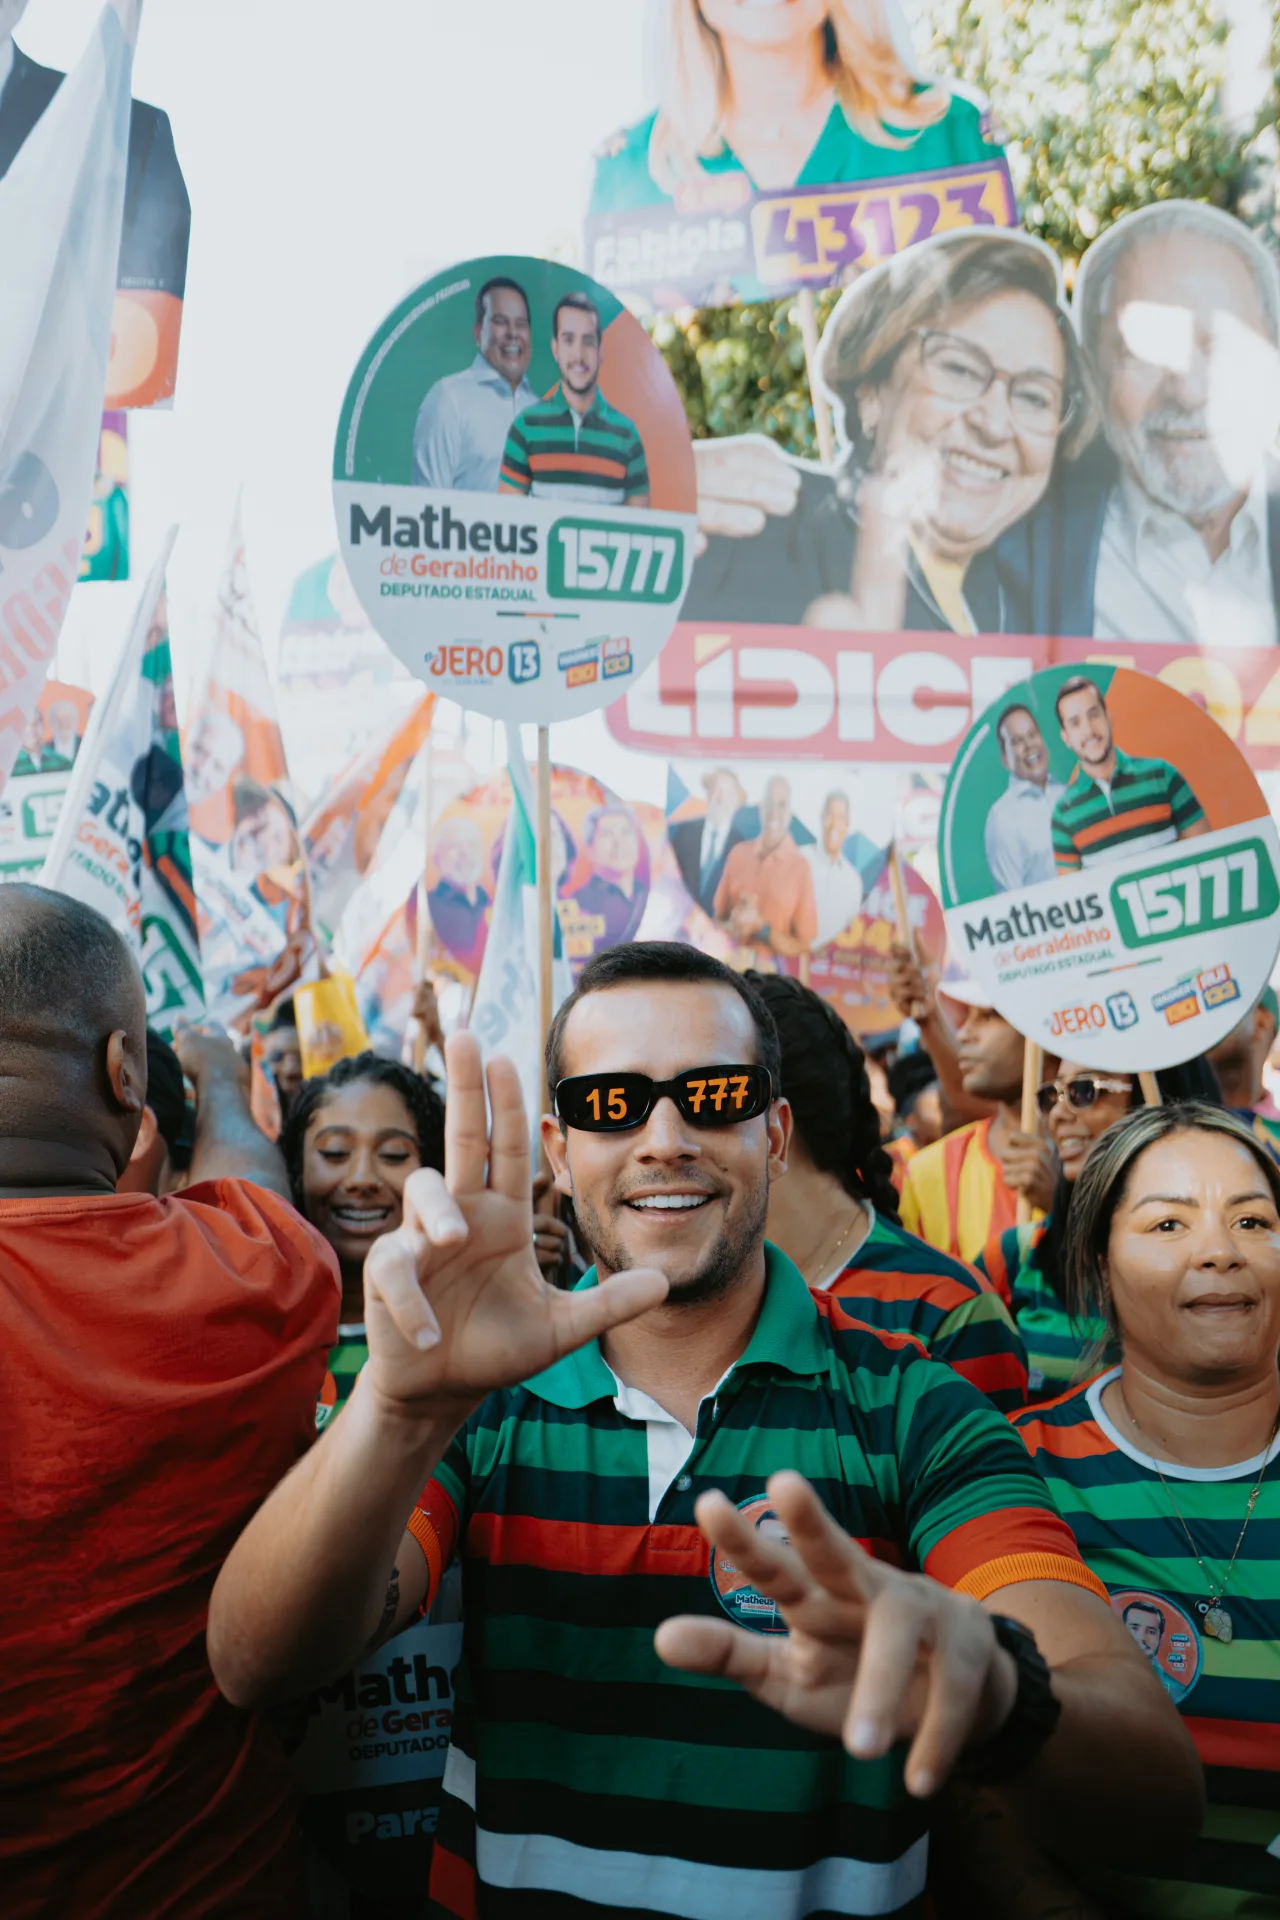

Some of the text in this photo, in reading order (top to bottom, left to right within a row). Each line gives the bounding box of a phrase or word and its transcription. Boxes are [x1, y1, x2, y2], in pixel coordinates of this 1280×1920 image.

[766, 181, 996, 266] 43123
[350, 504, 538, 555] Matheus
[380, 553, 538, 582] de Geraldinho
[558, 527, 676, 595] 15777
[380, 582, 538, 603] DEPUTADO ESTADUAL
[430, 646, 504, 677] JERO
[512, 645, 538, 678] 13
[1116, 847, 1259, 939] 15777
[964, 892, 1104, 951] Matheus
[1013, 926, 1112, 963] Geraldinho
[1050, 996, 1135, 1036] JERO 13
[586, 1075, 749, 1121] 15 777
[736, 1594, 774, 1605] Matheus
[308, 1654, 456, 1716] Math
[346, 1714, 379, 1741] de
[349, 1734, 450, 1761] DEPUTADO
